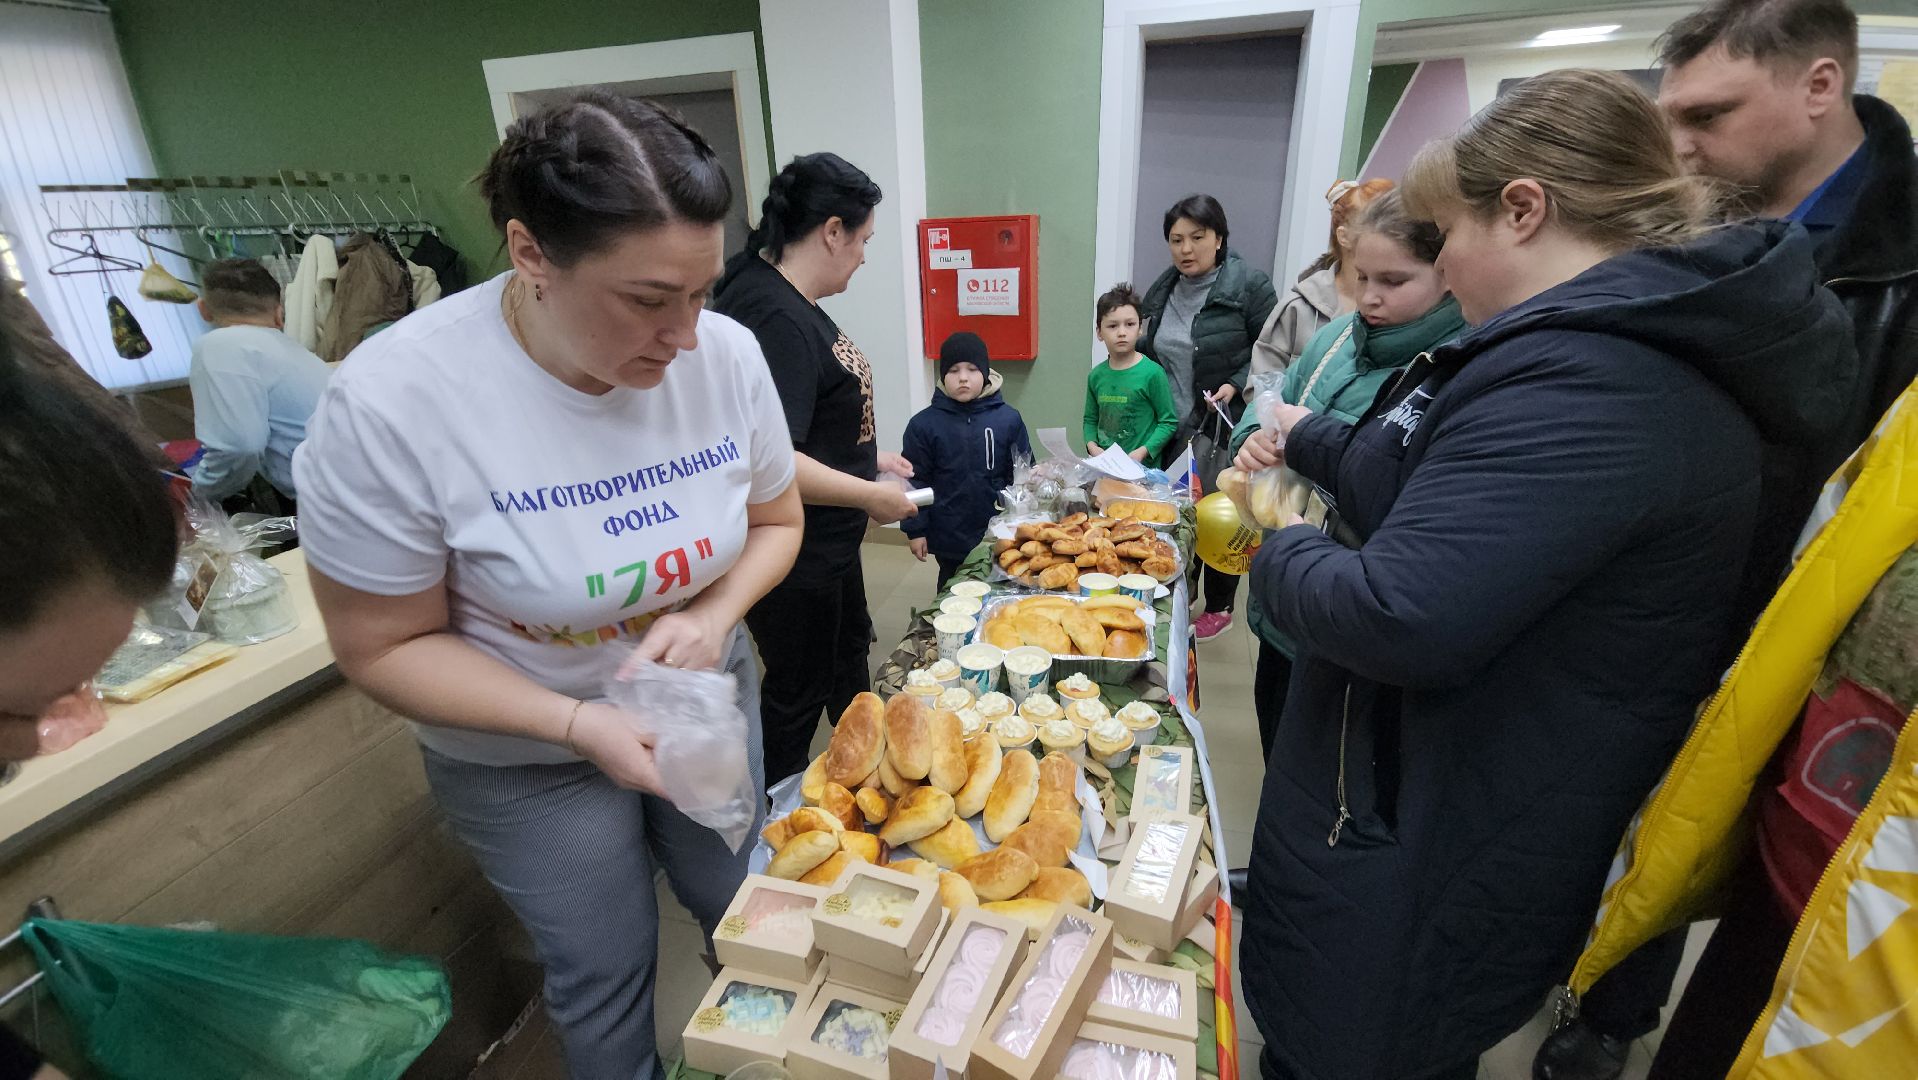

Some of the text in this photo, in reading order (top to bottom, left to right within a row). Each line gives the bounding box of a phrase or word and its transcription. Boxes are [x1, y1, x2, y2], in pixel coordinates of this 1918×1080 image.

[982, 278, 1009, 293] 112
[490, 435, 740, 515] БЛАГОТВОРИТЕЛЬНЫЙ
[603, 500, 680, 537] ФОНД
